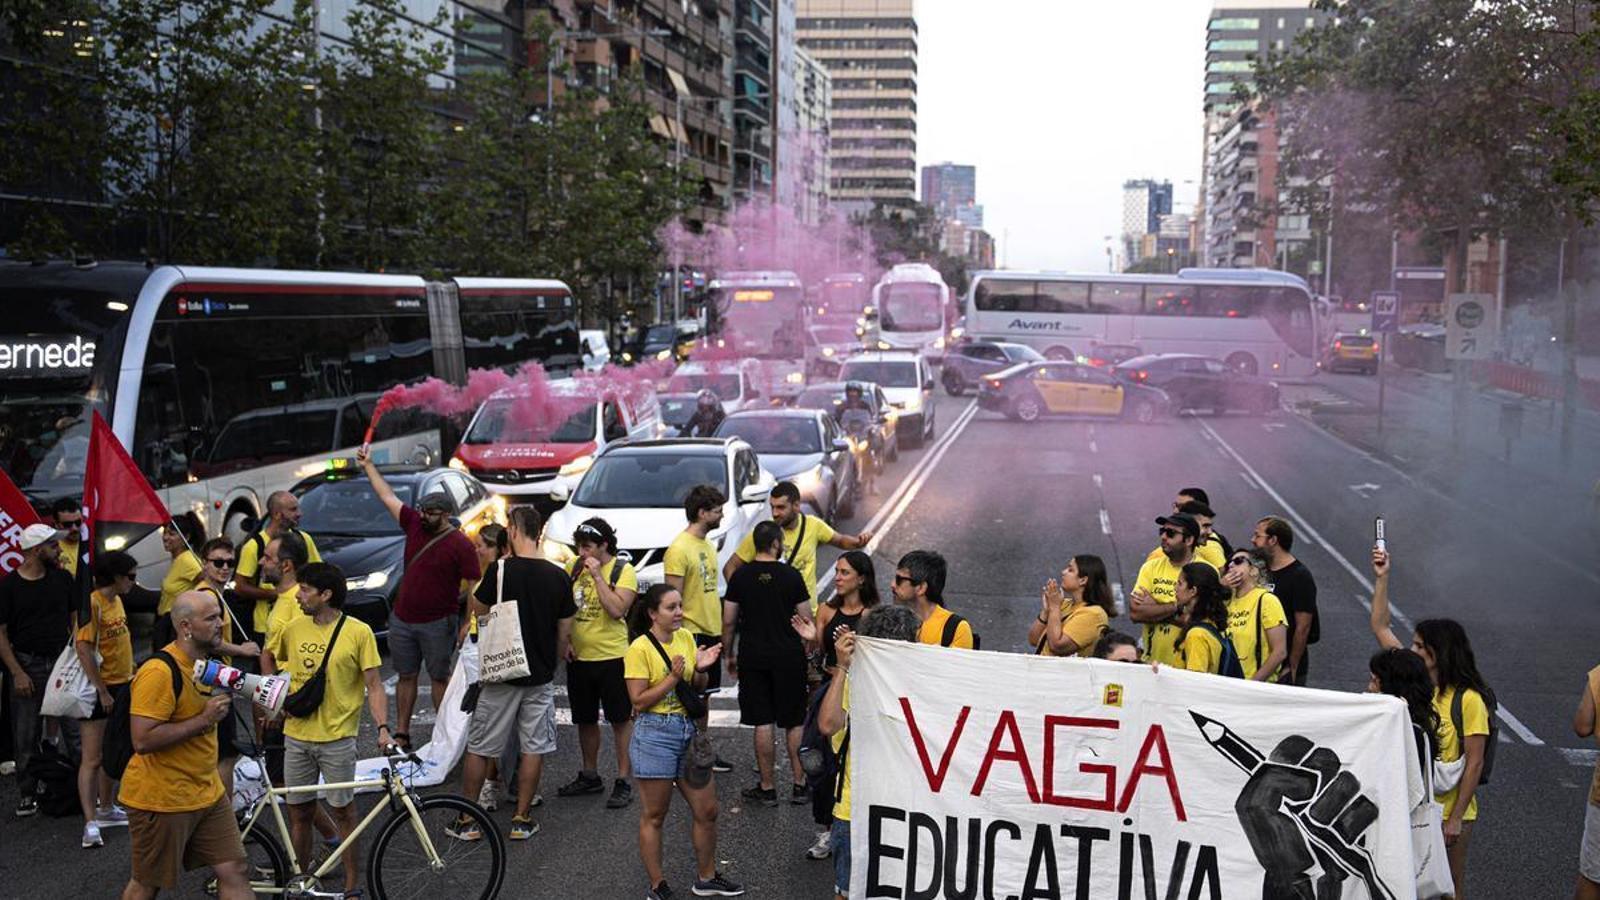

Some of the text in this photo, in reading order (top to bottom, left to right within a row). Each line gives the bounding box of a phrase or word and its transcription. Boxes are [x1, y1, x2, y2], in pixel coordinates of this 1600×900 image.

[1008, 318, 1062, 330] Avant
[299, 641, 326, 654] SOS
[898, 696, 1188, 823] VAGA
